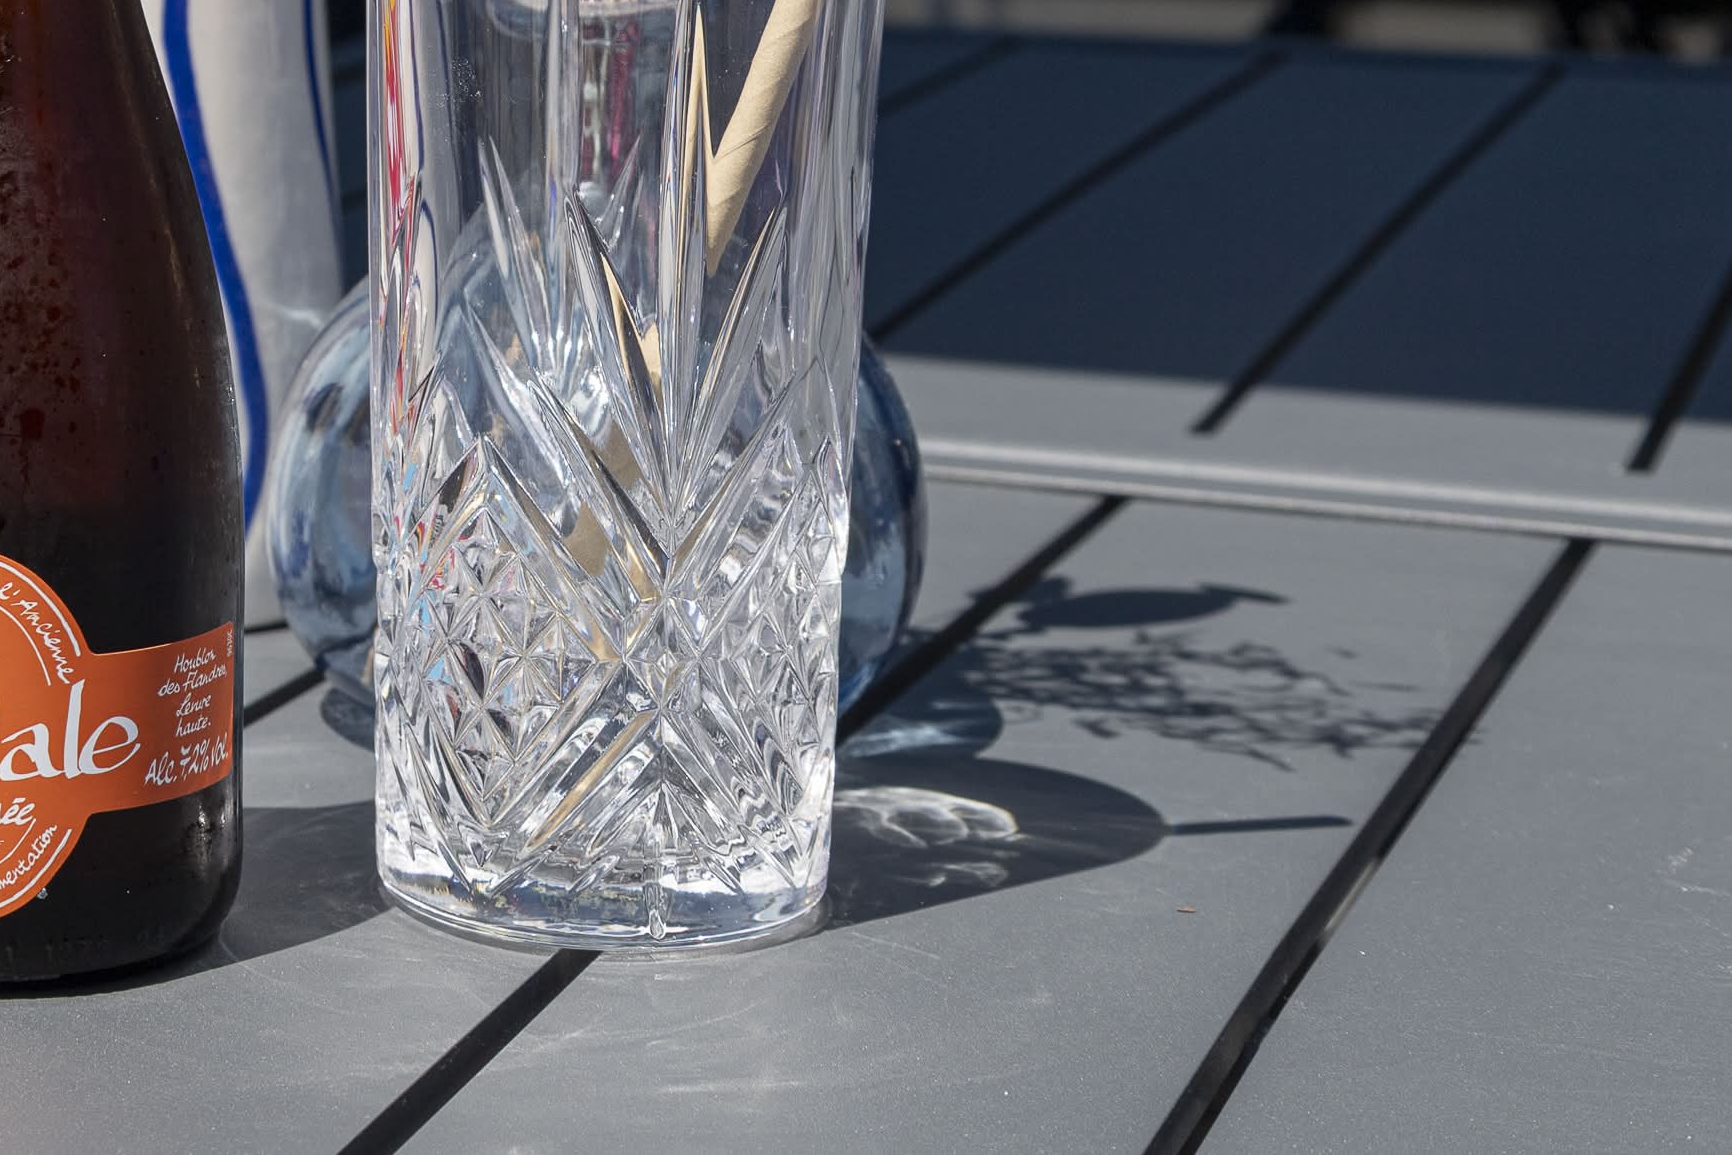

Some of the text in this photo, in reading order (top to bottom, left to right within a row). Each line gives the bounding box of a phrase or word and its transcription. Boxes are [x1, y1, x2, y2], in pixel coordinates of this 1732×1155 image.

[174, 647, 217, 673] Houblon
[158, 677, 181, 696] des
[143, 751, 177, 787] Alc.
